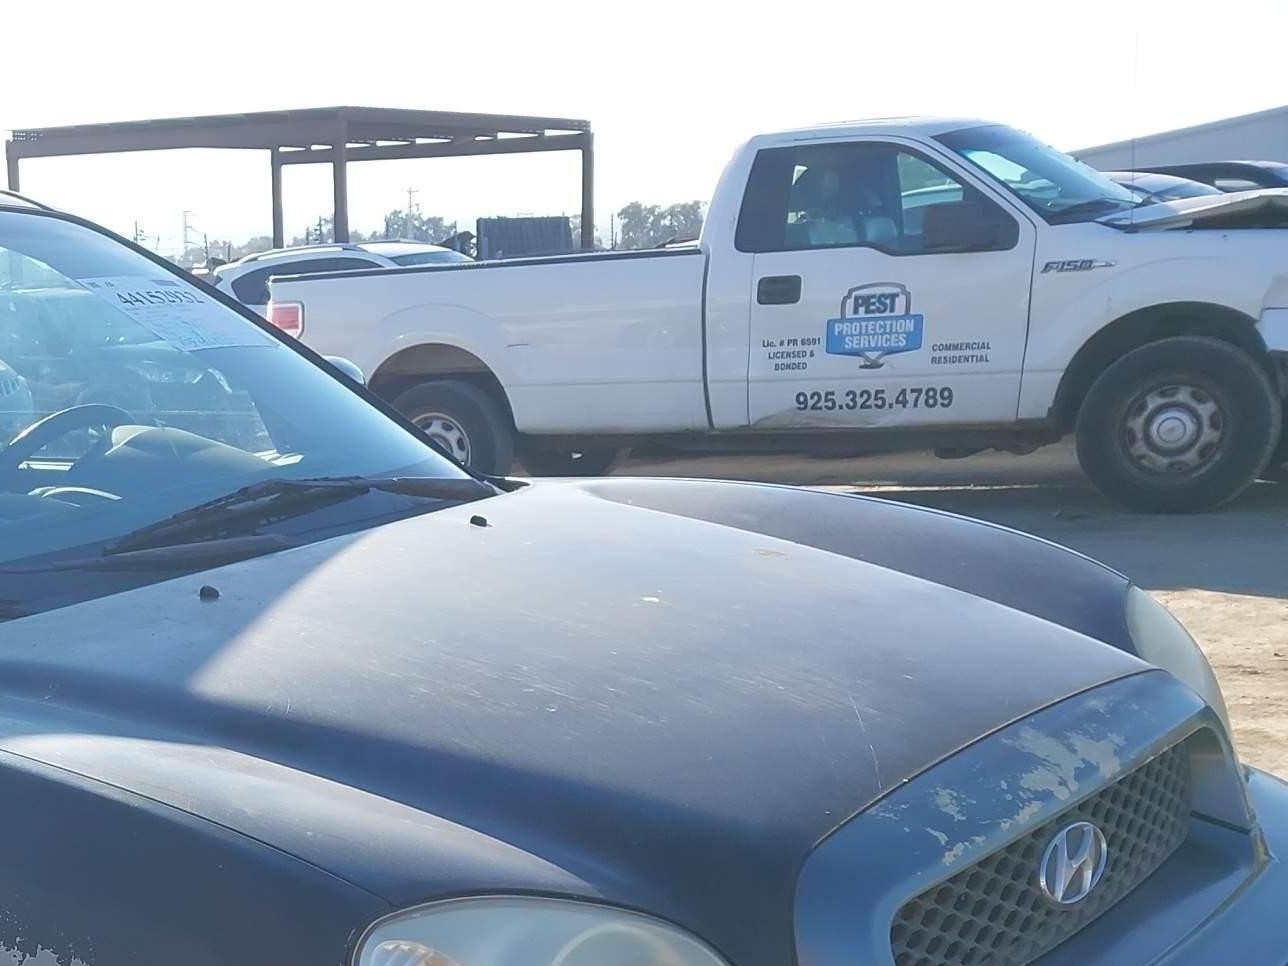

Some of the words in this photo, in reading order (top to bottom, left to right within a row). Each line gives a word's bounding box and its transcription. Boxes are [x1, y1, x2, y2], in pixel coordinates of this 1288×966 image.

[852, 293, 900, 315] PEST
[834, 318, 914, 336] PROTECTION
[787, 338, 798, 347] PR
[844, 333, 907, 349] SERVICES
[931, 342, 992, 352] COMMERCIAL
[768, 350, 808, 360] LICENSED
[931, 354, 990, 365] RESIDENTIAL
[774, 362, 808, 371] BONDED
[795, 386, 955, 412] 925.325.4789
